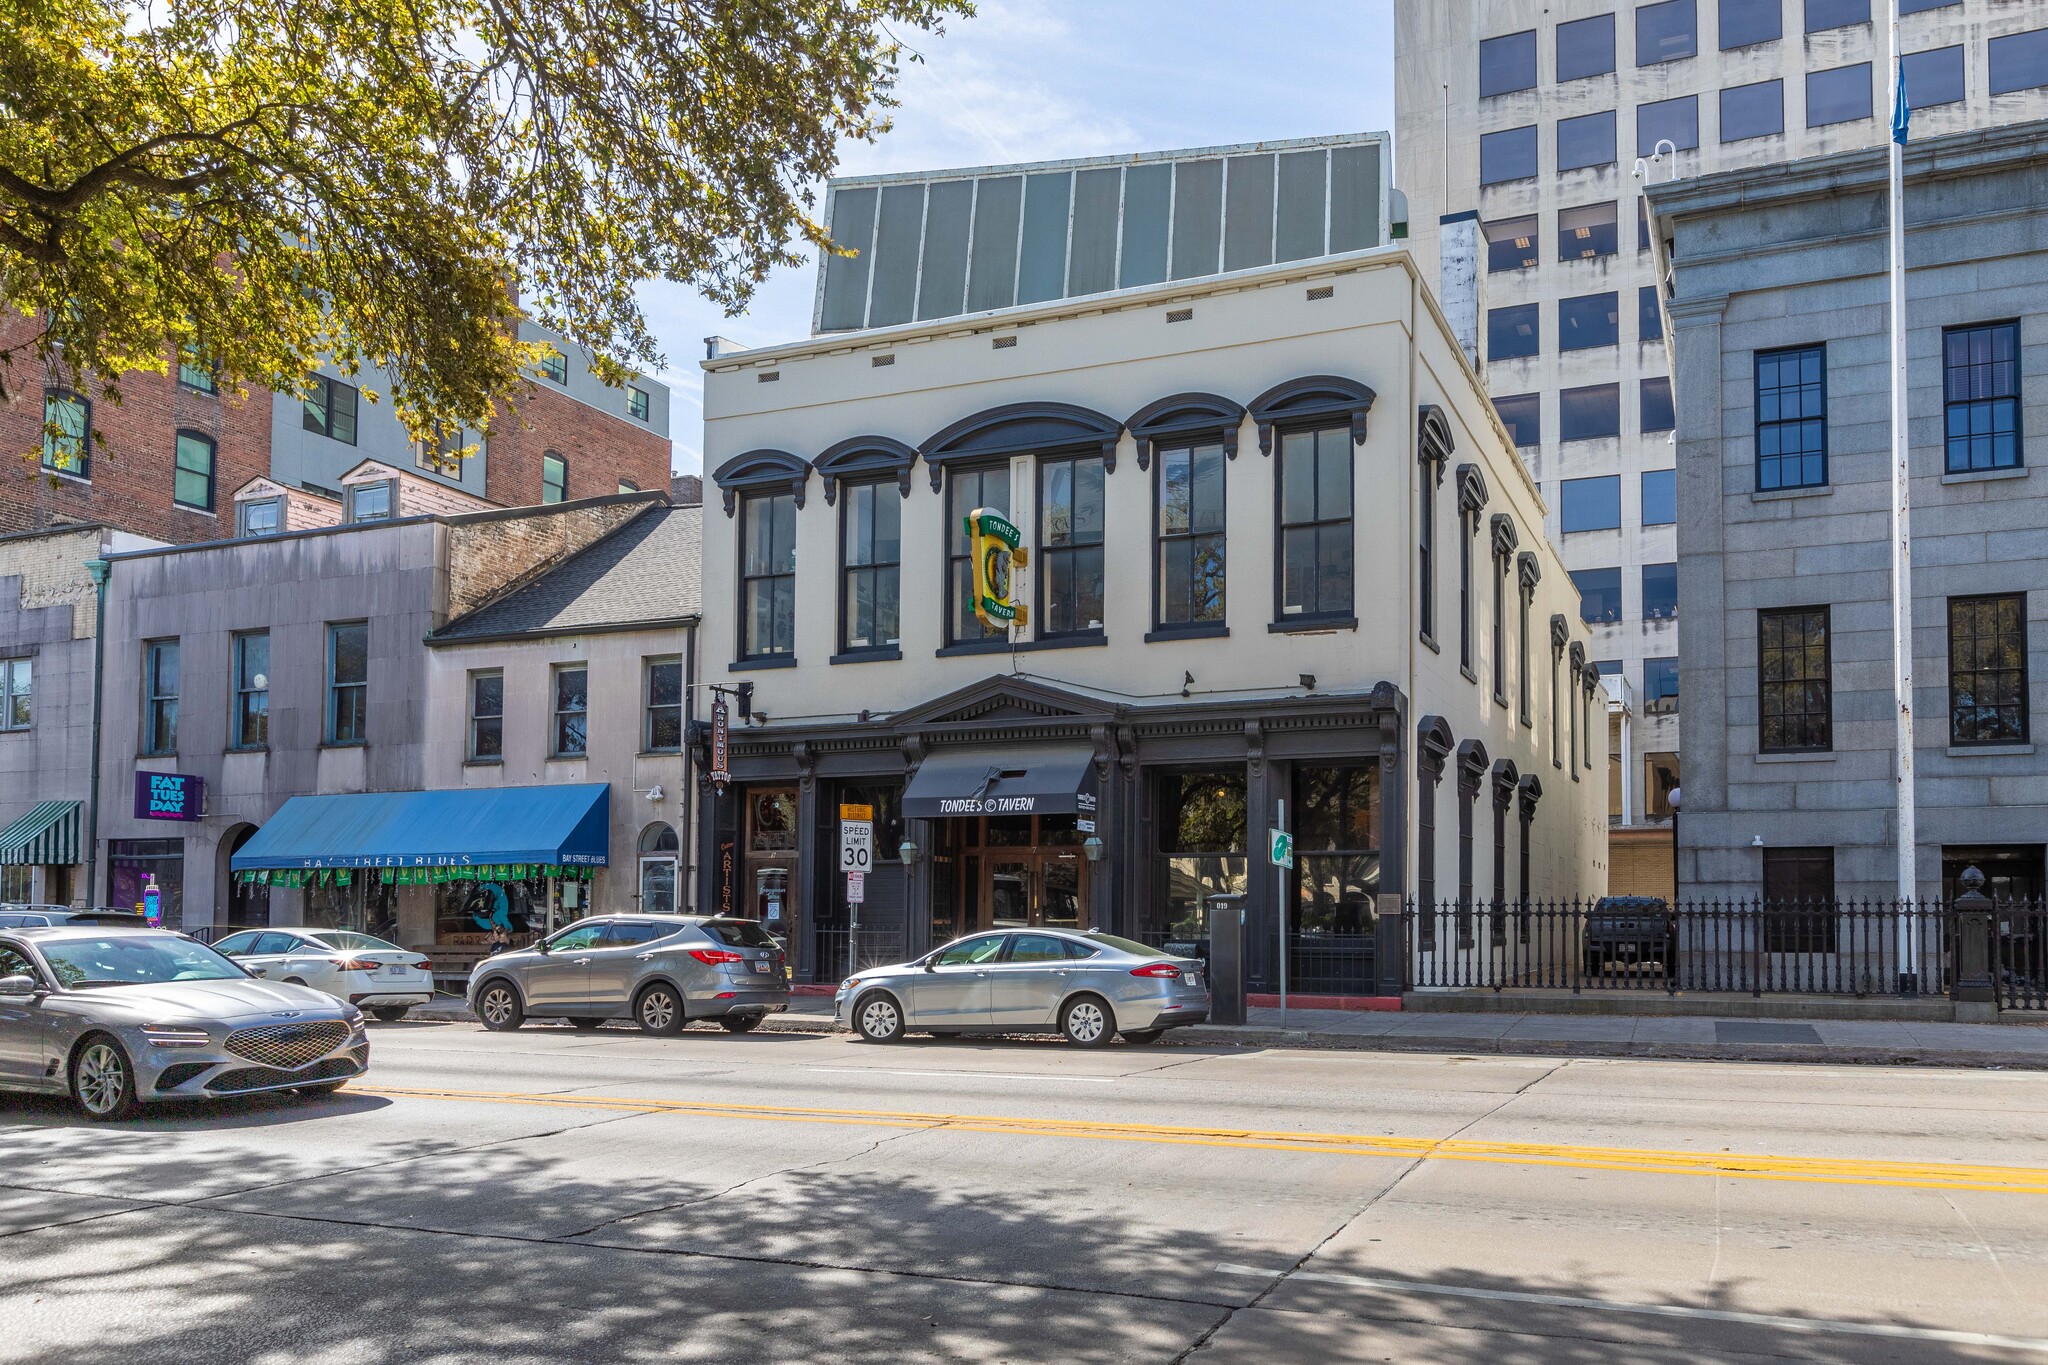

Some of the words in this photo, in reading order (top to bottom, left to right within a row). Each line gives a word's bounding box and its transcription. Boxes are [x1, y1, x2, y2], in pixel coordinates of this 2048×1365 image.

[989, 520, 1019, 541] TONDEE'S
[991, 601, 1015, 618] TAVERN
[715, 705, 726, 769] ANONYMOUS
[150, 775, 185, 790] FAT
[150, 789, 185, 801] TUES
[150, 799, 184, 812] DAY
[940, 799, 983, 813] TONDEE'S
[998, 797, 1035, 811] TAVERN
[843, 826, 870, 836] SPEED
[846, 837, 867, 845] LIMIT
[562, 854, 572, 863] BAY
[572, 854, 591, 863] STREET
[590, 855, 606, 864] BLUES
[844, 847, 868, 866] 30
[722, 851, 731, 912] ARTISTS
[1216, 902, 1228, 910] 019
